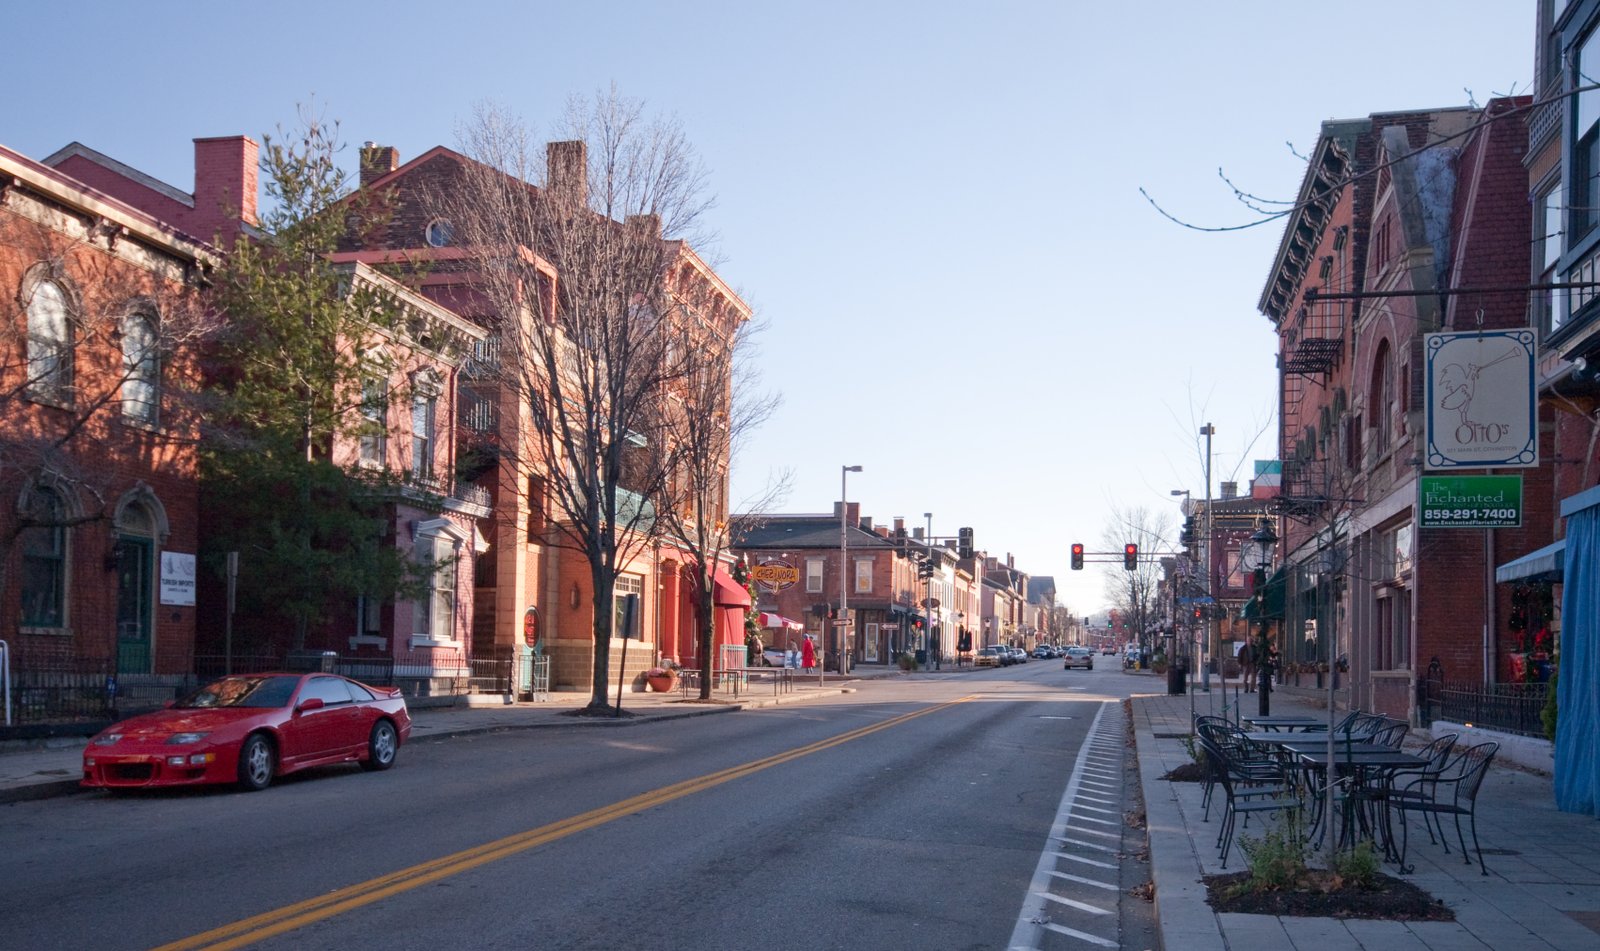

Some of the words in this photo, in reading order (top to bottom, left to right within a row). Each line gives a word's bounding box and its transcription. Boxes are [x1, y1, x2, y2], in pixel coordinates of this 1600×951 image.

[1428, 482, 1448, 493] The
[1426, 489, 1504, 505] Enchanted
[1424, 508, 1516, 519] 859-291-7400
[756, 568, 774, 579] CHEZ
